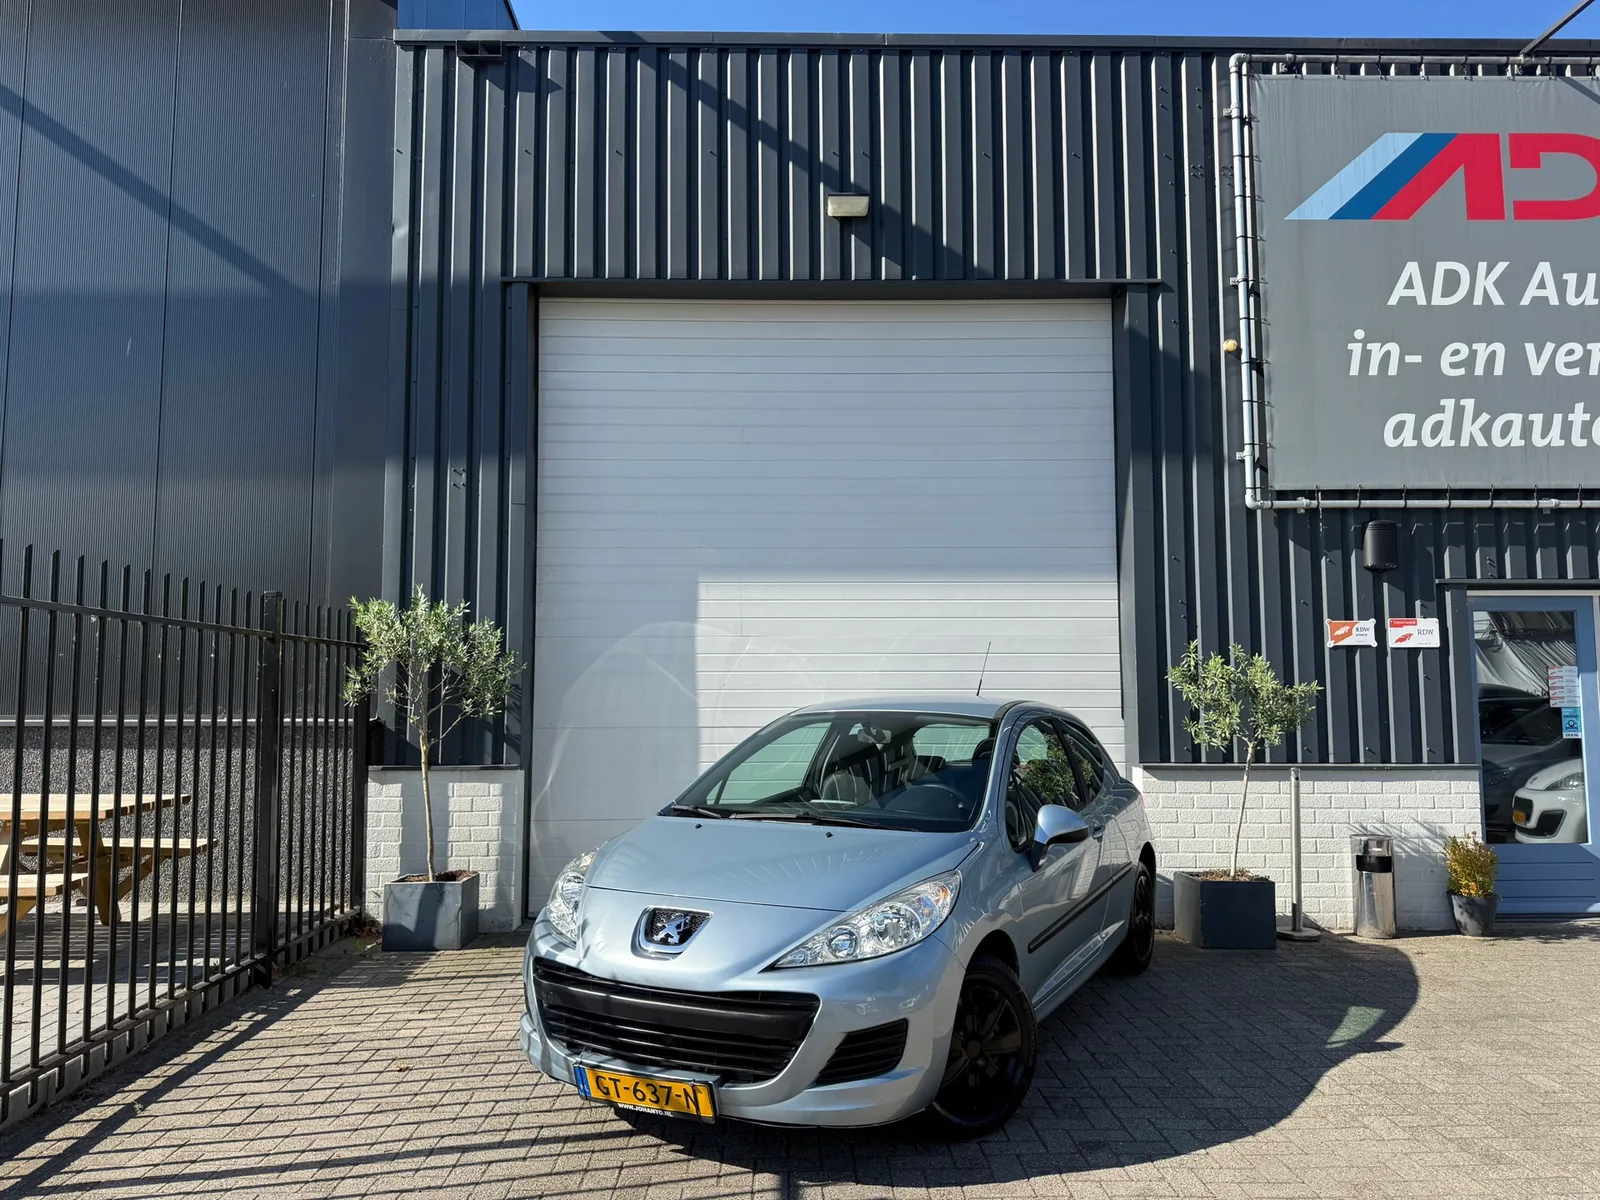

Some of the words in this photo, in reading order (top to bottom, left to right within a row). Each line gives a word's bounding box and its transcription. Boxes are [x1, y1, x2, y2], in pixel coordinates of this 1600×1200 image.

[1386, 261, 1510, 306] ADK
[1519, 261, 1600, 306] Au
[1346, 328, 1422, 376] in-
[1439, 340, 1506, 377] en
[1524, 341, 1600, 377] ver
[1417, 628, 1434, 636] RDW
[595, 1075, 699, 1113] GT-637-N
